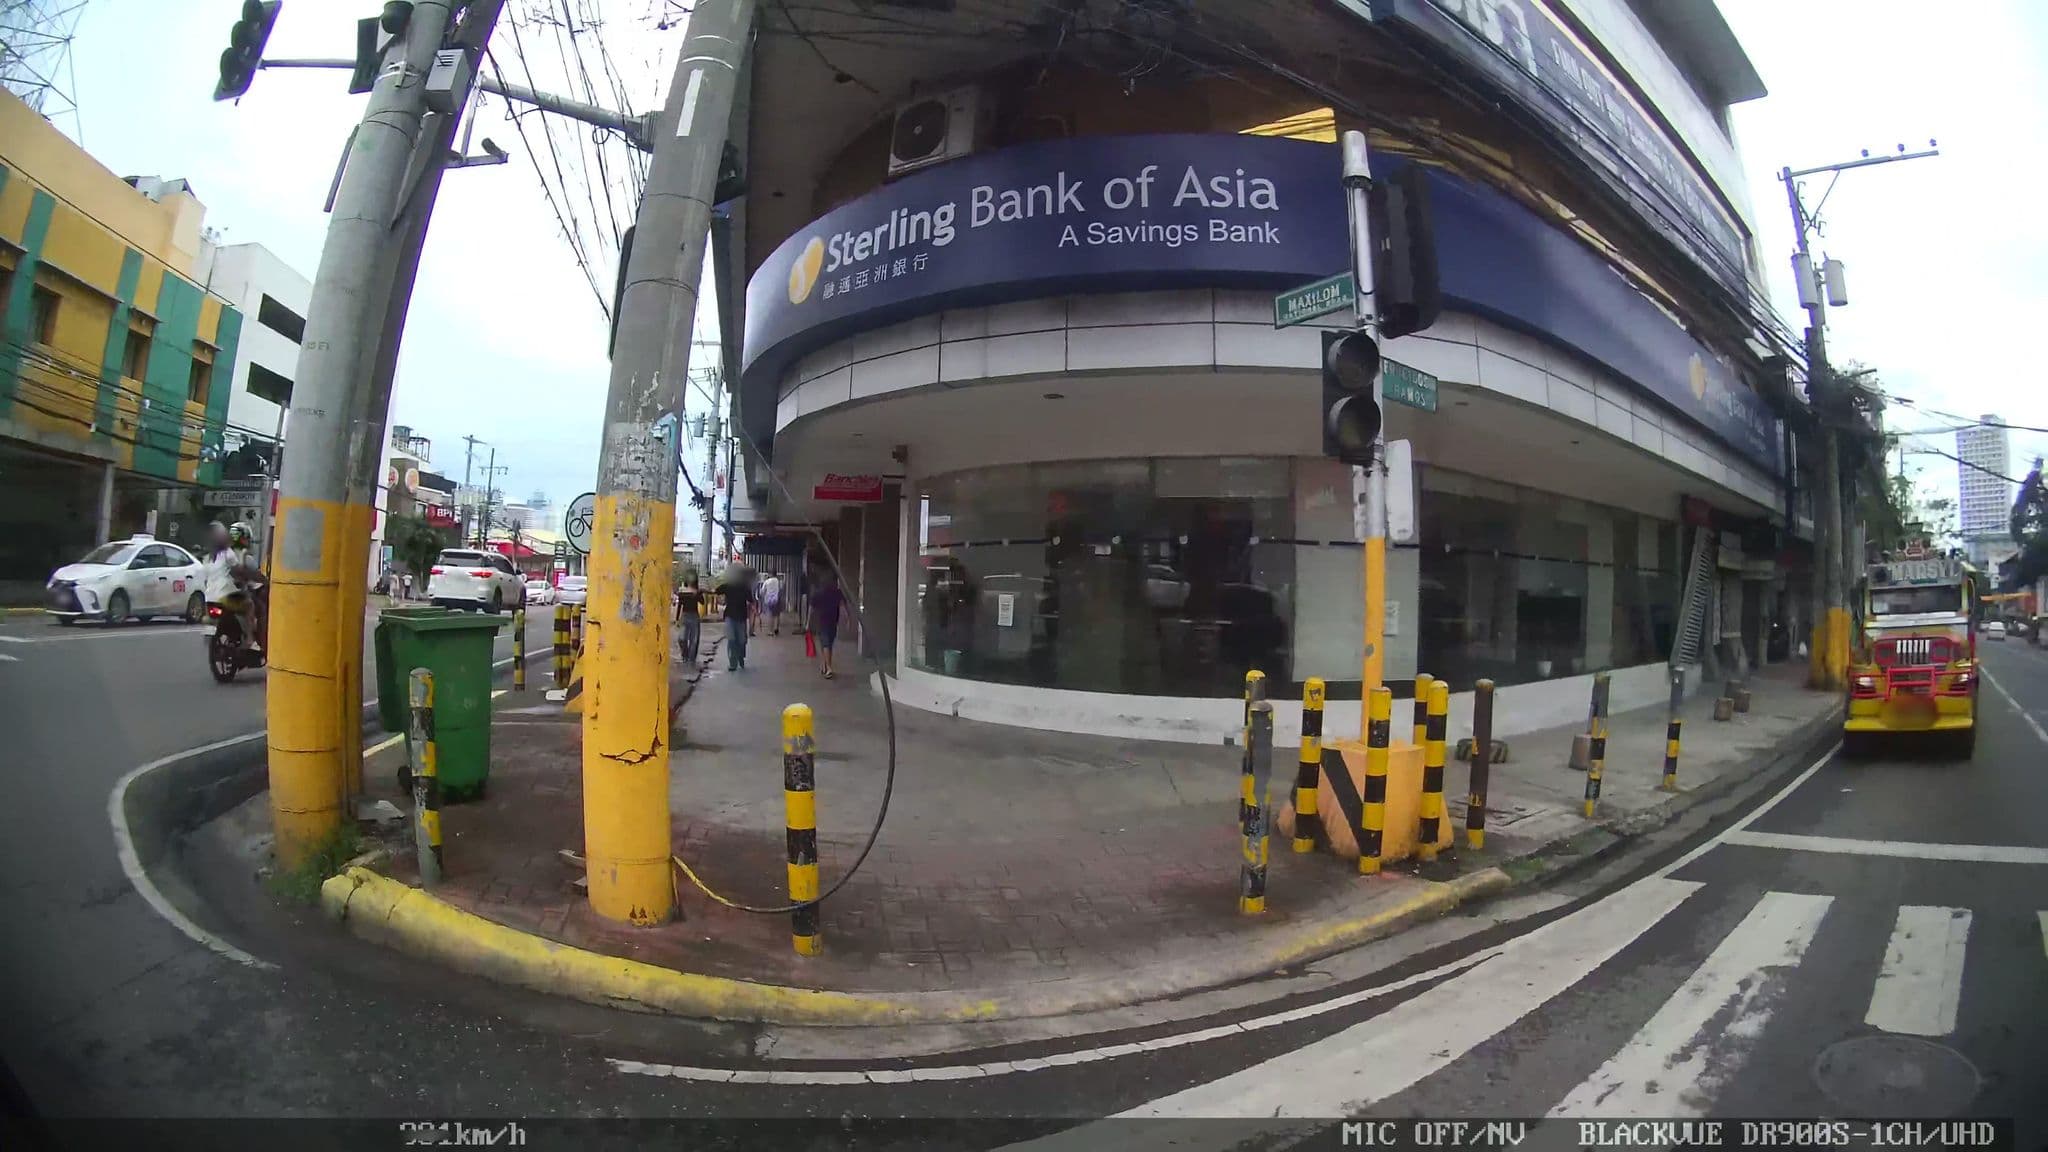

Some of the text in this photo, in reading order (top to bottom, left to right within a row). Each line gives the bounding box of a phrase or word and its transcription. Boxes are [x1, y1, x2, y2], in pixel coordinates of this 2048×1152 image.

[826, 165, 1280, 273] Sterling Bank of Asia
[1058, 219, 1280, 248] A Savings Bank
[1288, 283, 1340, 312] MAXILOM
